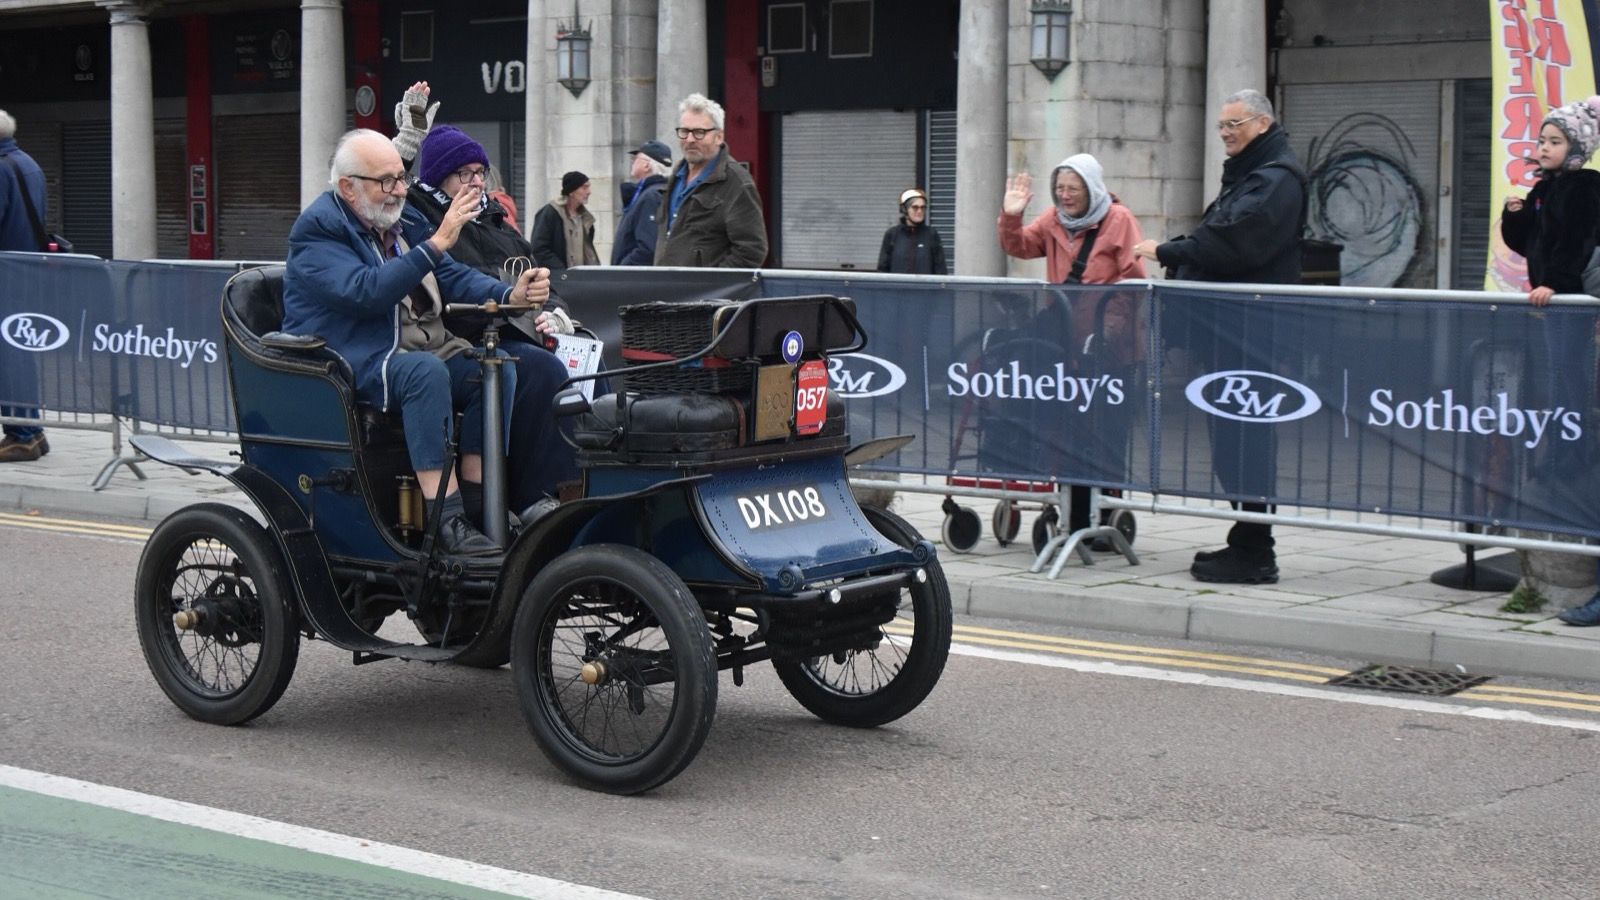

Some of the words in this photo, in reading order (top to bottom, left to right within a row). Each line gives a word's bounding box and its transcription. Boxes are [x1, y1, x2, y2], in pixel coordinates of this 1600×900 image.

[93, 323, 218, 368] Sotheby's
[796, 386, 827, 411] 057
[947, 360, 1125, 413] Sotheby's
[1368, 388, 1583, 449] Sotheby's
[737, 494, 783, 529] DX
[777, 486, 826, 522] 108
